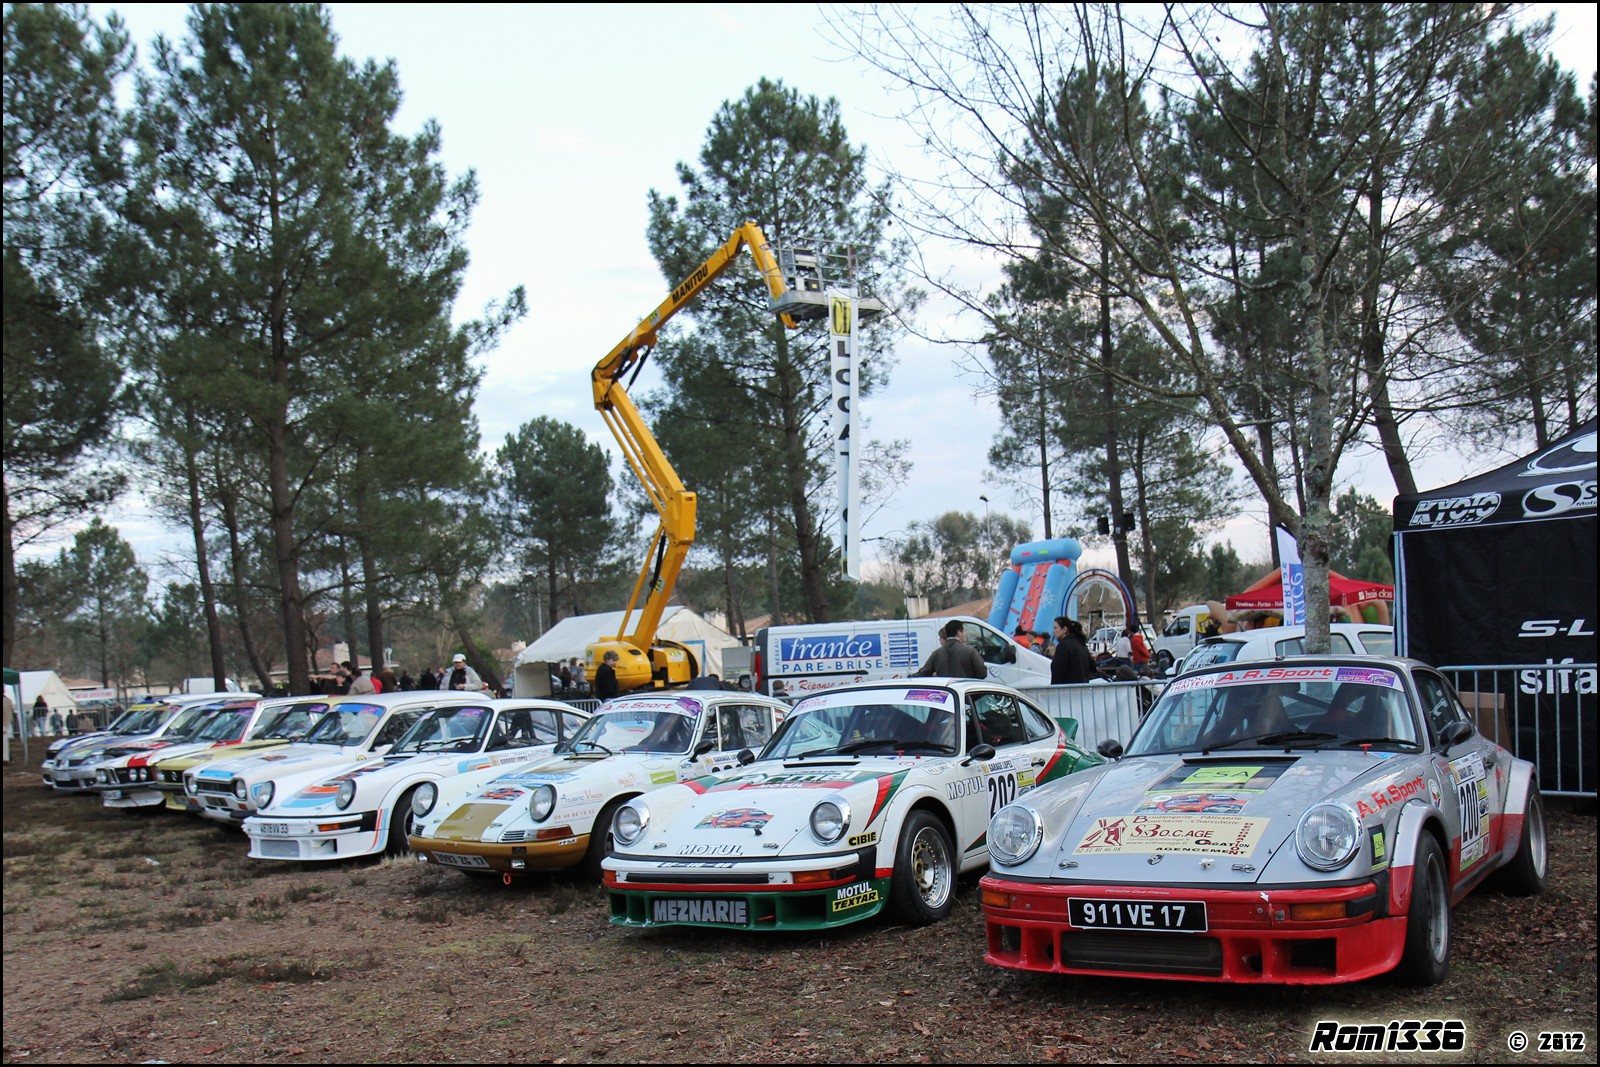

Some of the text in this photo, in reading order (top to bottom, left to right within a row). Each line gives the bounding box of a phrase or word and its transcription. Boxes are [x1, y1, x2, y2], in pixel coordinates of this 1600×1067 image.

[672, 264, 709, 306] MANITOU
[1409, 492, 1501, 525] KYOTO
[1364, 588, 1393, 600] huis clos
[789, 635, 873, 660] france
[781, 659, 883, 673] PARE-BRISE
[1218, 667, 1334, 682] A.R.Sport
[799, 679, 835, 693] Réponse
[988, 759, 1014, 772] GARAGE LOPEZ
[1192, 770, 1249, 779] CSA
[945, 775, 986, 800] MOTUL
[987, 773, 1016, 820] 202
[1355, 776, 1426, 819] A.R.Sport
[1459, 780, 1479, 843] 200
[849, 832, 877, 847] CIBIE
[676, 844, 743, 856] MOTUL
[1155, 847, 1247, 855] AGENCEMENT
[837, 881, 873, 900] MOTUL
[653, 899, 747, 923] MEZNARIE
[833, 892, 878, 911] TEXTAR
[1083, 902, 1186, 927] 911 VE 17
